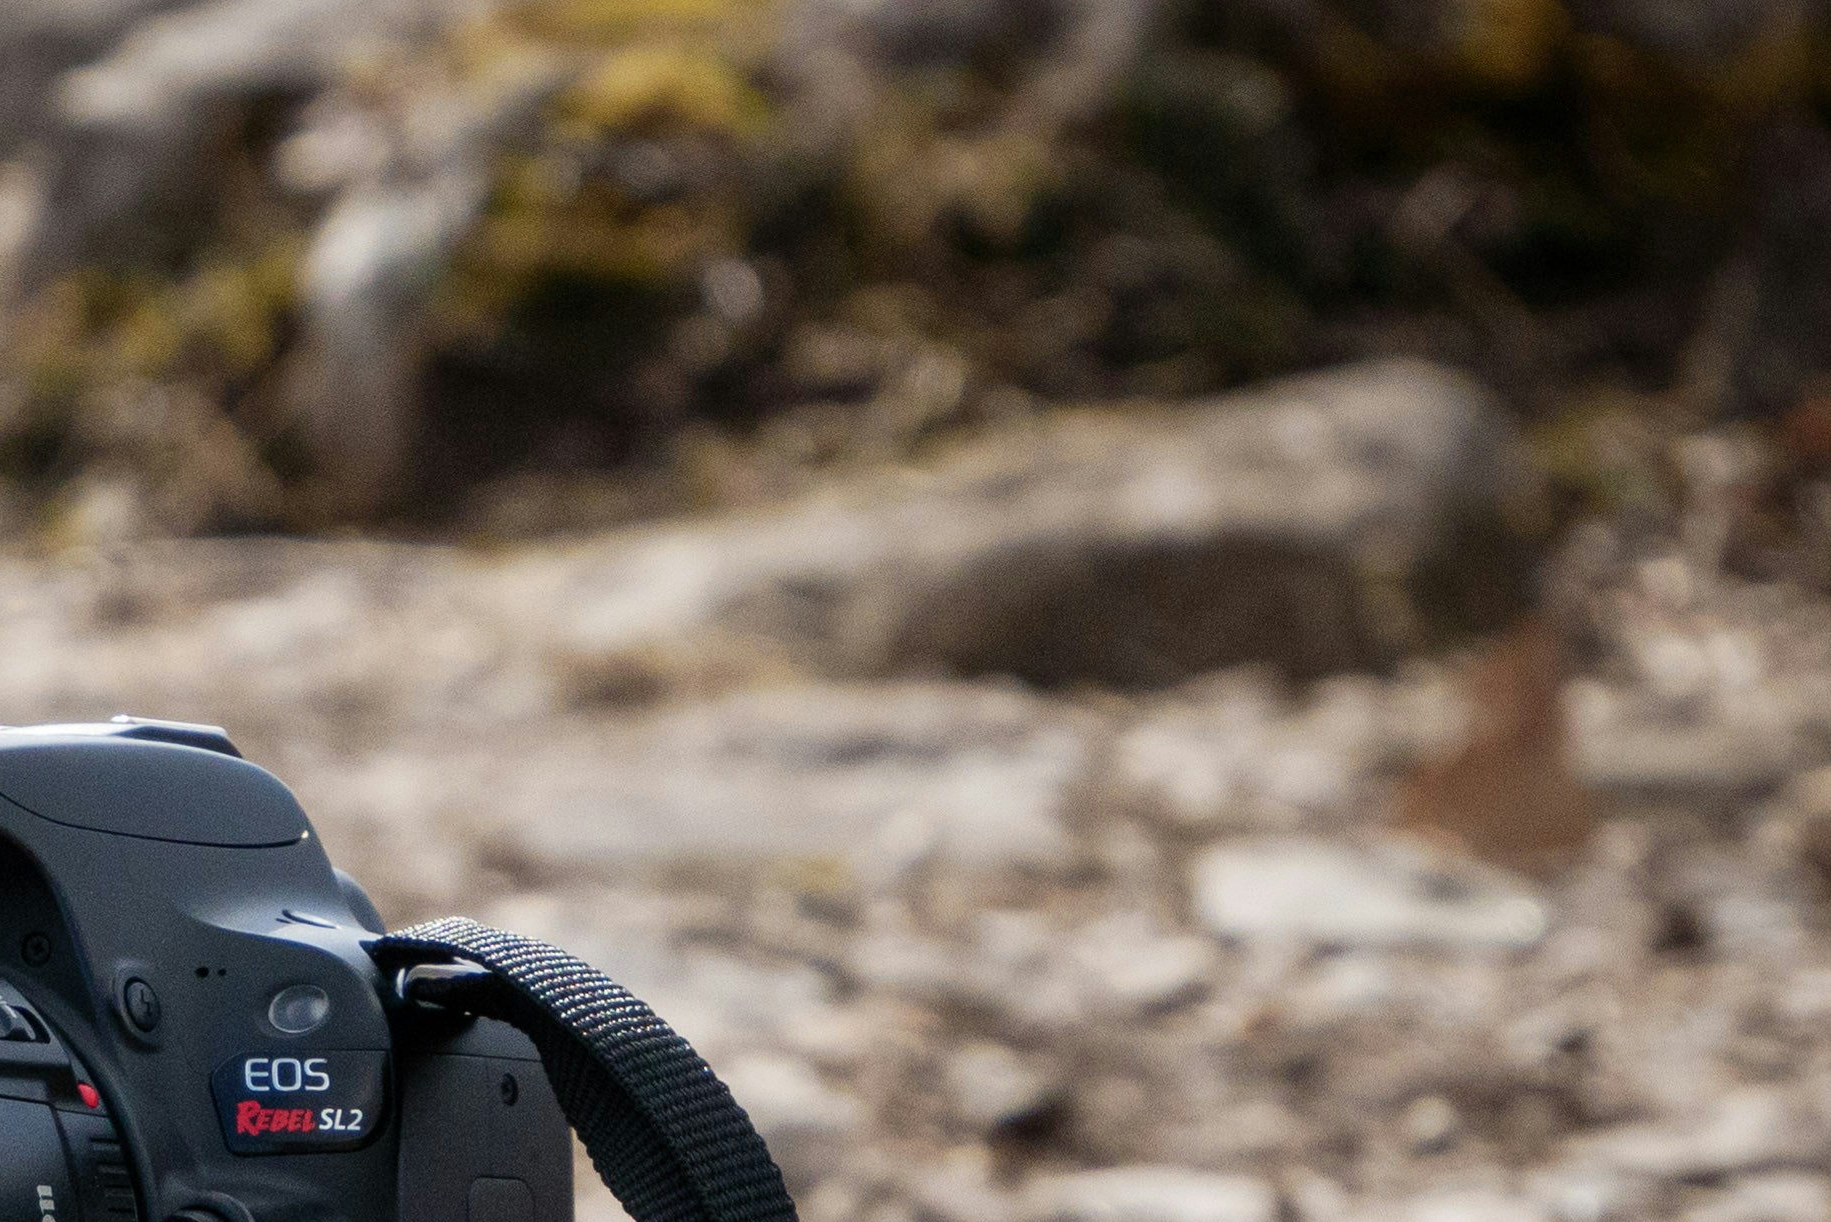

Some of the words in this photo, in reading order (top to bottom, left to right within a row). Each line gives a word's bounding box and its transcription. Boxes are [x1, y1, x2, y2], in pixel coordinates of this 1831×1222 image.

[245, 1057, 330, 1092] EOS
[236, 1099, 315, 1136] REBEL
[319, 1108, 363, 1131] SL2
